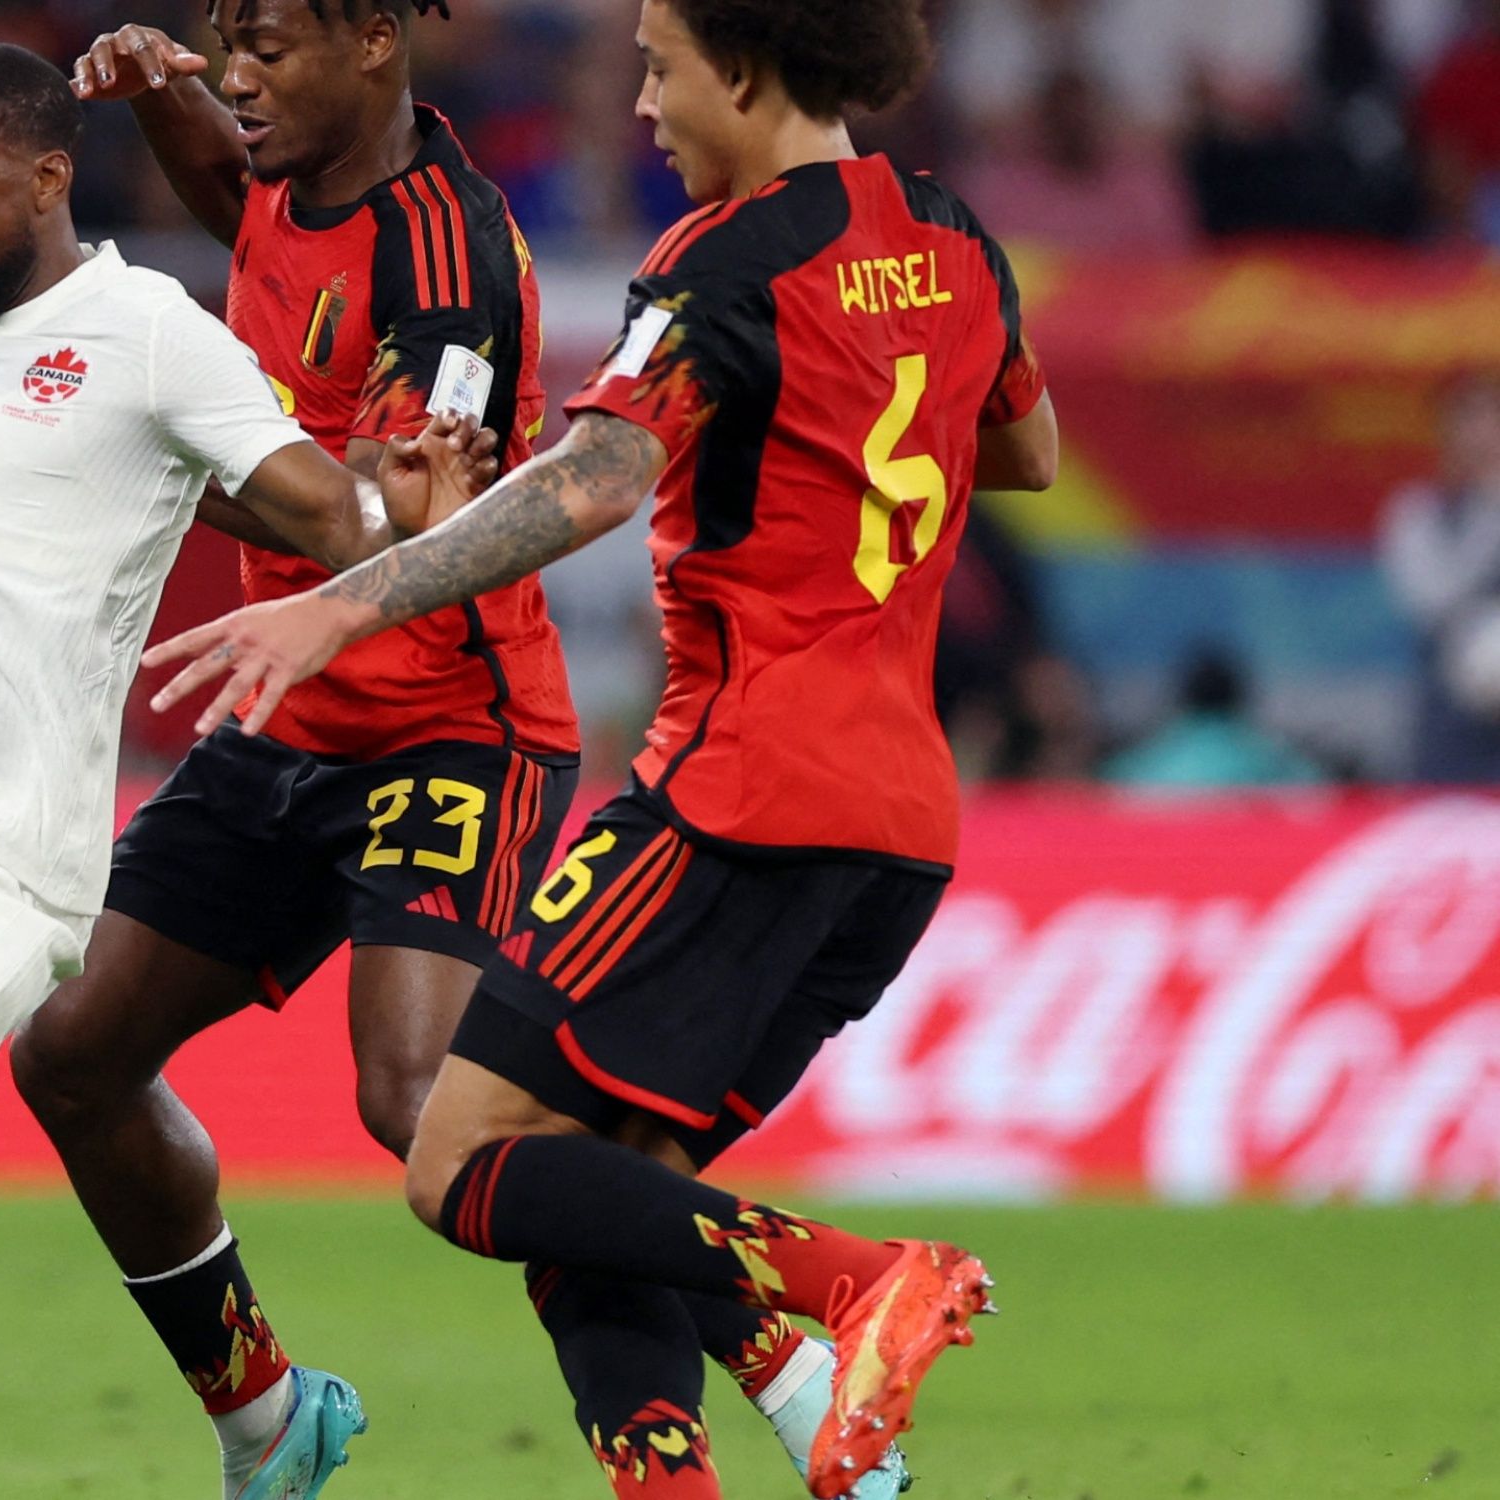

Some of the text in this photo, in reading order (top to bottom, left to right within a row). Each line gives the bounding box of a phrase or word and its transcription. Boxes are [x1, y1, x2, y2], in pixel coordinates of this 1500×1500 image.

[836, 249, 953, 315] WITSEL
[25, 367, 83, 386] CANADA
[852, 352, 946, 606] 6
[360, 777, 487, 876] 23
[530, 829, 618, 924] 6
